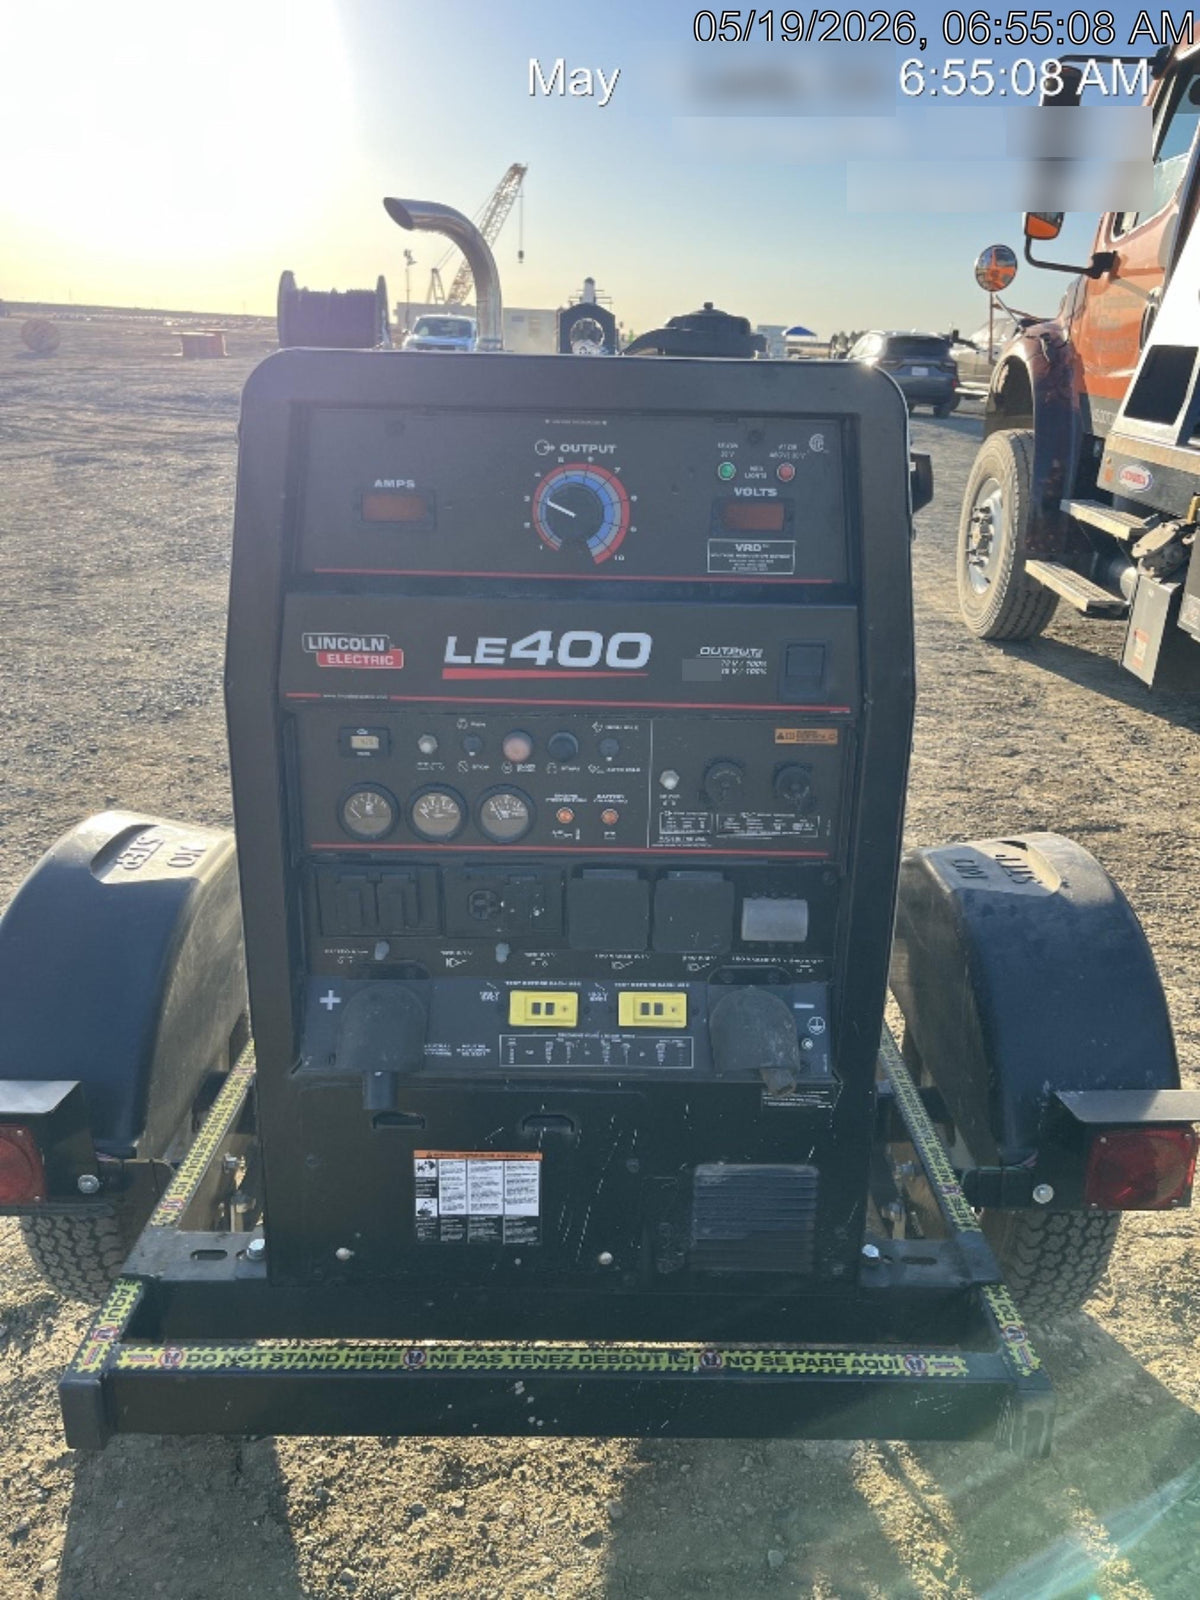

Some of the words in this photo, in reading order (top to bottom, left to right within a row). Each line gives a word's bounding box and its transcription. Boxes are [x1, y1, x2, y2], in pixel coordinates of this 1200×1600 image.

[560, 444, 617, 454] OUTPUT
[374, 478, 416, 489] AMPS
[734, 487, 778, 497] VOLTS
[308, 636, 385, 652] LINCOLN
[443, 630, 653, 668] LE400
[327, 653, 395, 666] ELECTRIC
[116, 835, 166, 870] STEP
[186, 1352, 217, 1363] DO
[221, 1352, 267, 1364] NOT
[270, 1352, 340, 1363] STAND
[345, 1352, 400, 1363] HERE
[430, 1354, 458, 1364] NE
[462, 1354, 503, 1364] PAS
[508, 1354, 573, 1364] TENEZ
[579, 1354, 662, 1364] DEBOUT
[668, 1354, 694, 1365] ICI
[726, 1356, 756, 1366] NO
[760, 1356, 787, 1367] SE
[792, 1357, 847, 1368] PARE
